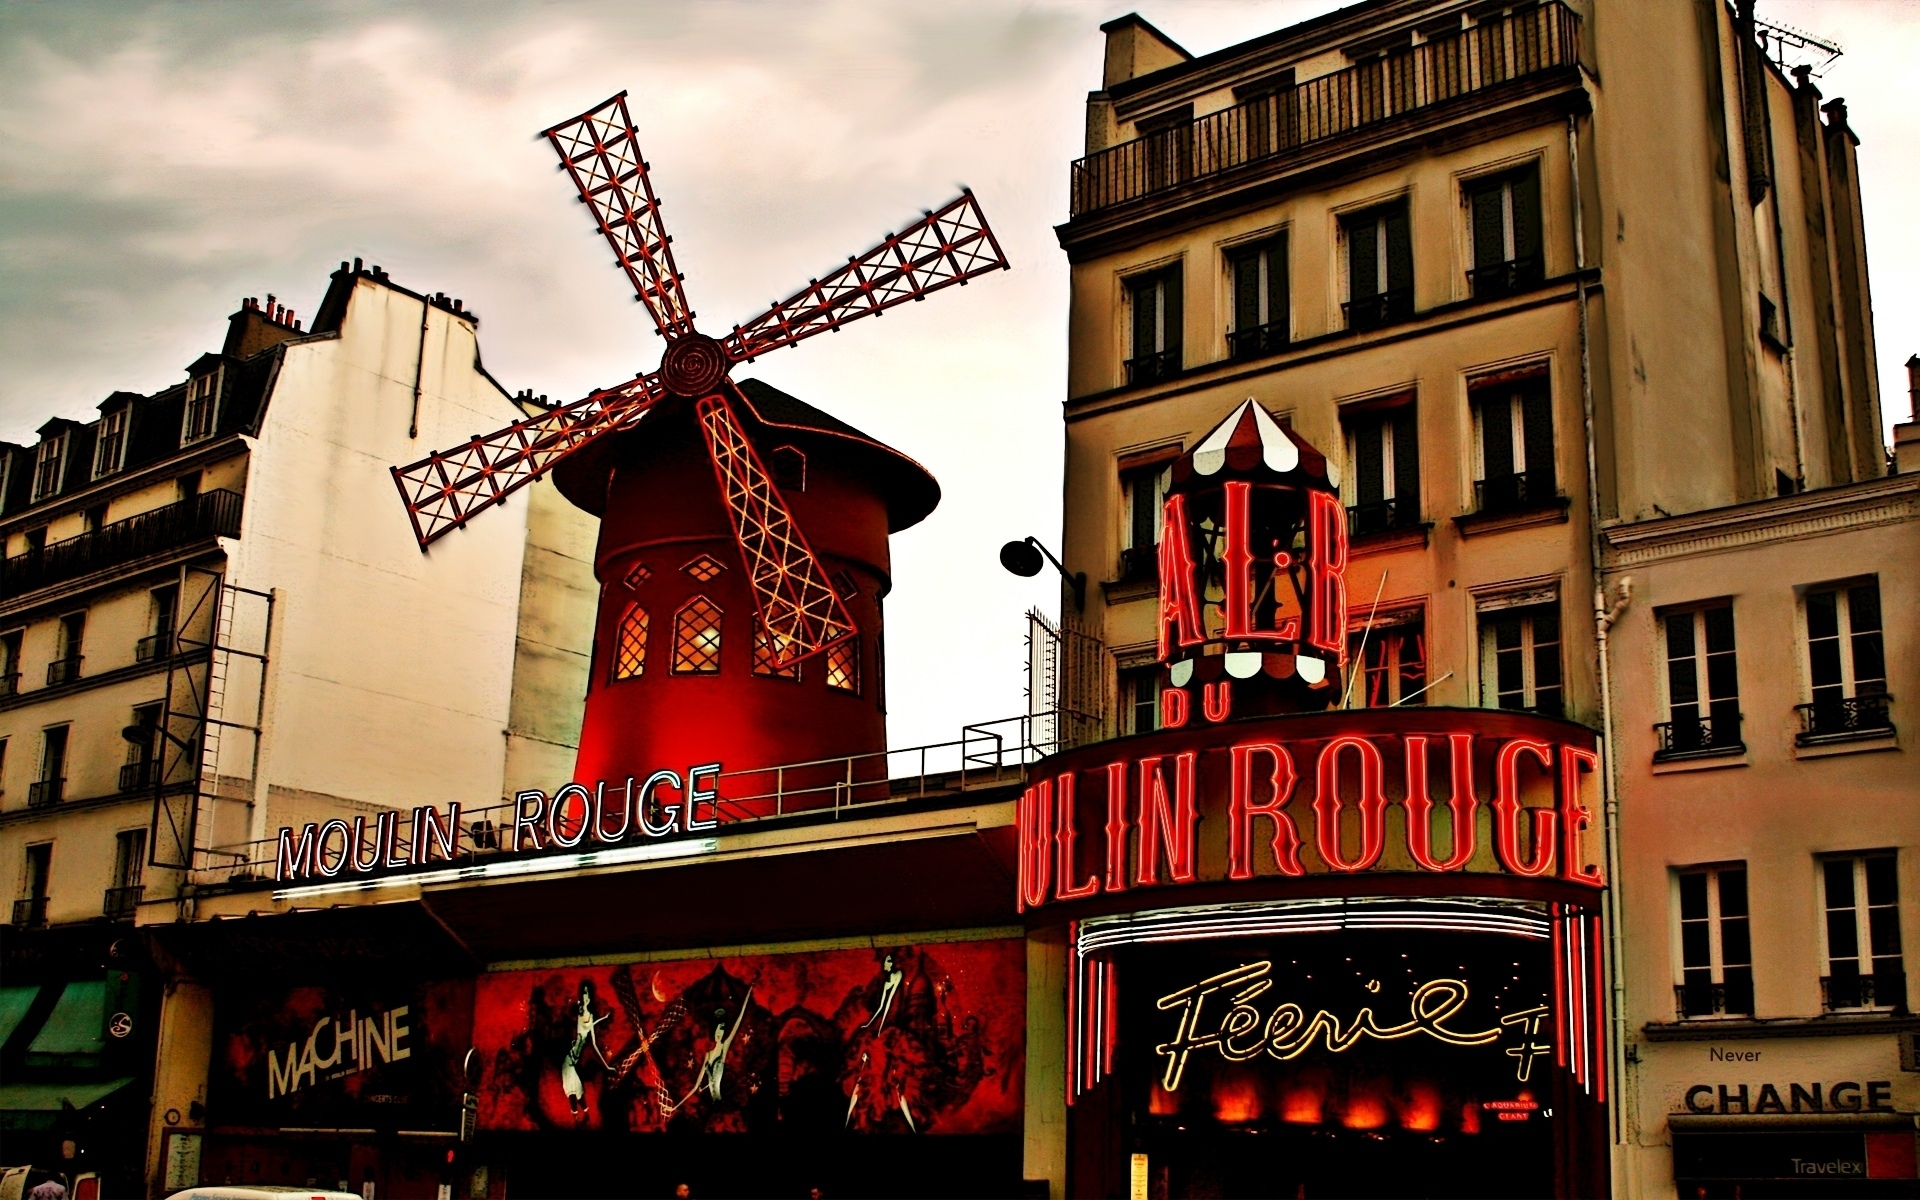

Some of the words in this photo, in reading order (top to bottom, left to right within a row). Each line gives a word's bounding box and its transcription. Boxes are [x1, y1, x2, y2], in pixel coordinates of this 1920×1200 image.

[1161, 681, 1232, 728] DU
[275, 801, 461, 882] MOULIN
[513, 763, 721, 852] ROUGE
[1017, 750, 1199, 915] ULIN
[1228, 733, 1606, 888] ROUGE
[268, 1005, 411, 1100] MACHINE
[1684, 1081, 1892, 1114] CHANGE
[1790, 1158, 1862, 1175] Travelex
